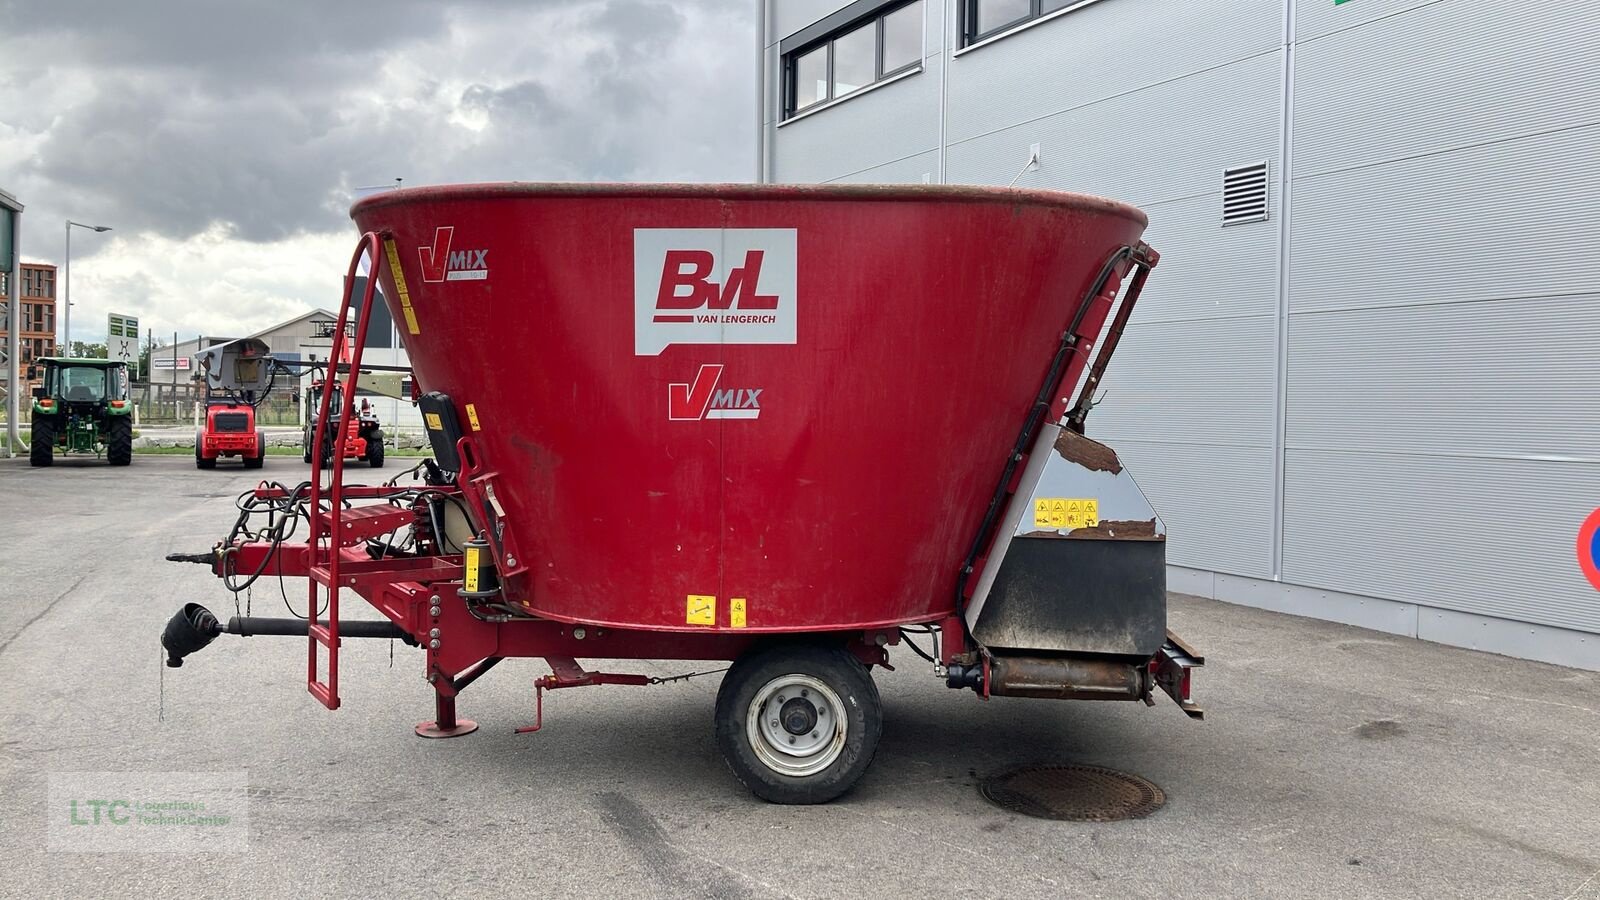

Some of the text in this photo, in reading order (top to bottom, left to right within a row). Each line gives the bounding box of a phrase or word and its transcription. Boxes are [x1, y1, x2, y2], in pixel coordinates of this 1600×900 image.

[656, 250, 779, 310] BvL
[697, 315, 776, 324] VAN LENGERICH
